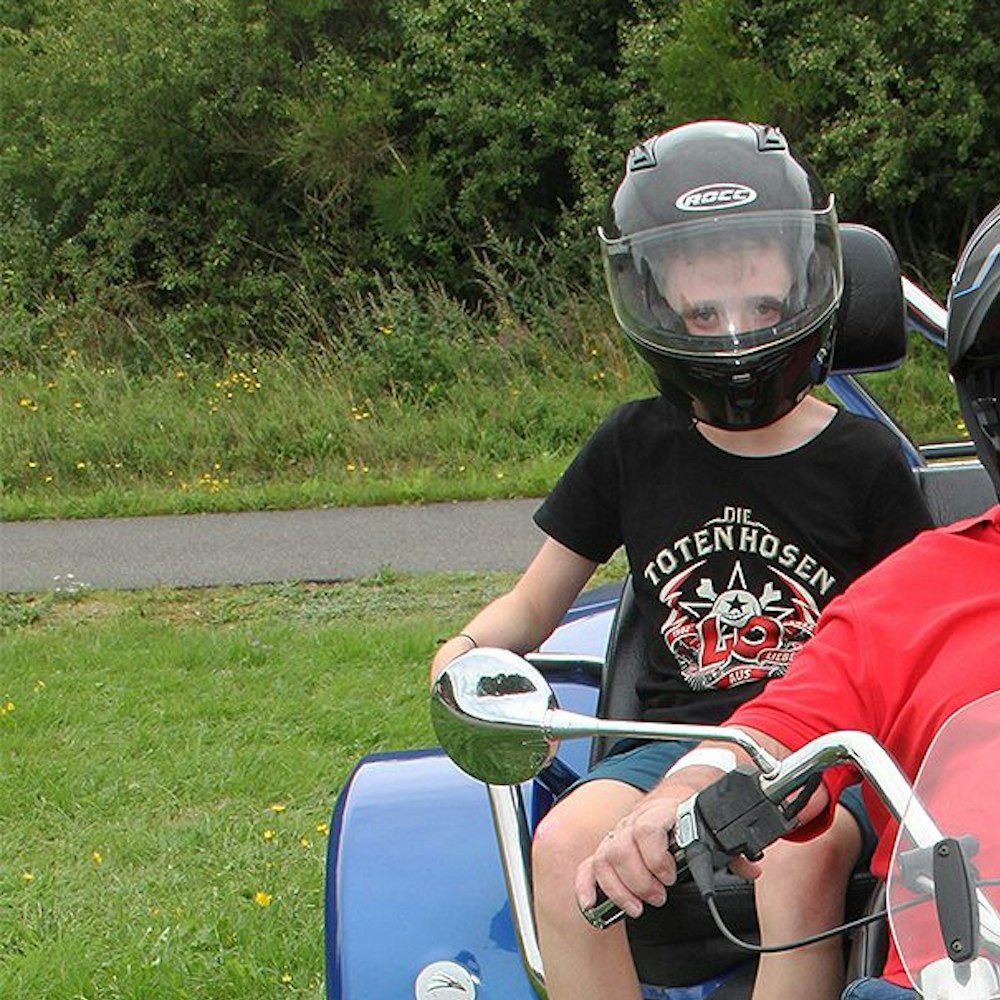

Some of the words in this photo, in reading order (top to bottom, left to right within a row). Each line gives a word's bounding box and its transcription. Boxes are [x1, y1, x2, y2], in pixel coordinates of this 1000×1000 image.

[723, 506, 752, 524] DIE
[644, 526, 734, 586] TOTEN
[739, 526, 836, 596] HOSEN
[728, 669, 752, 684] AUS
